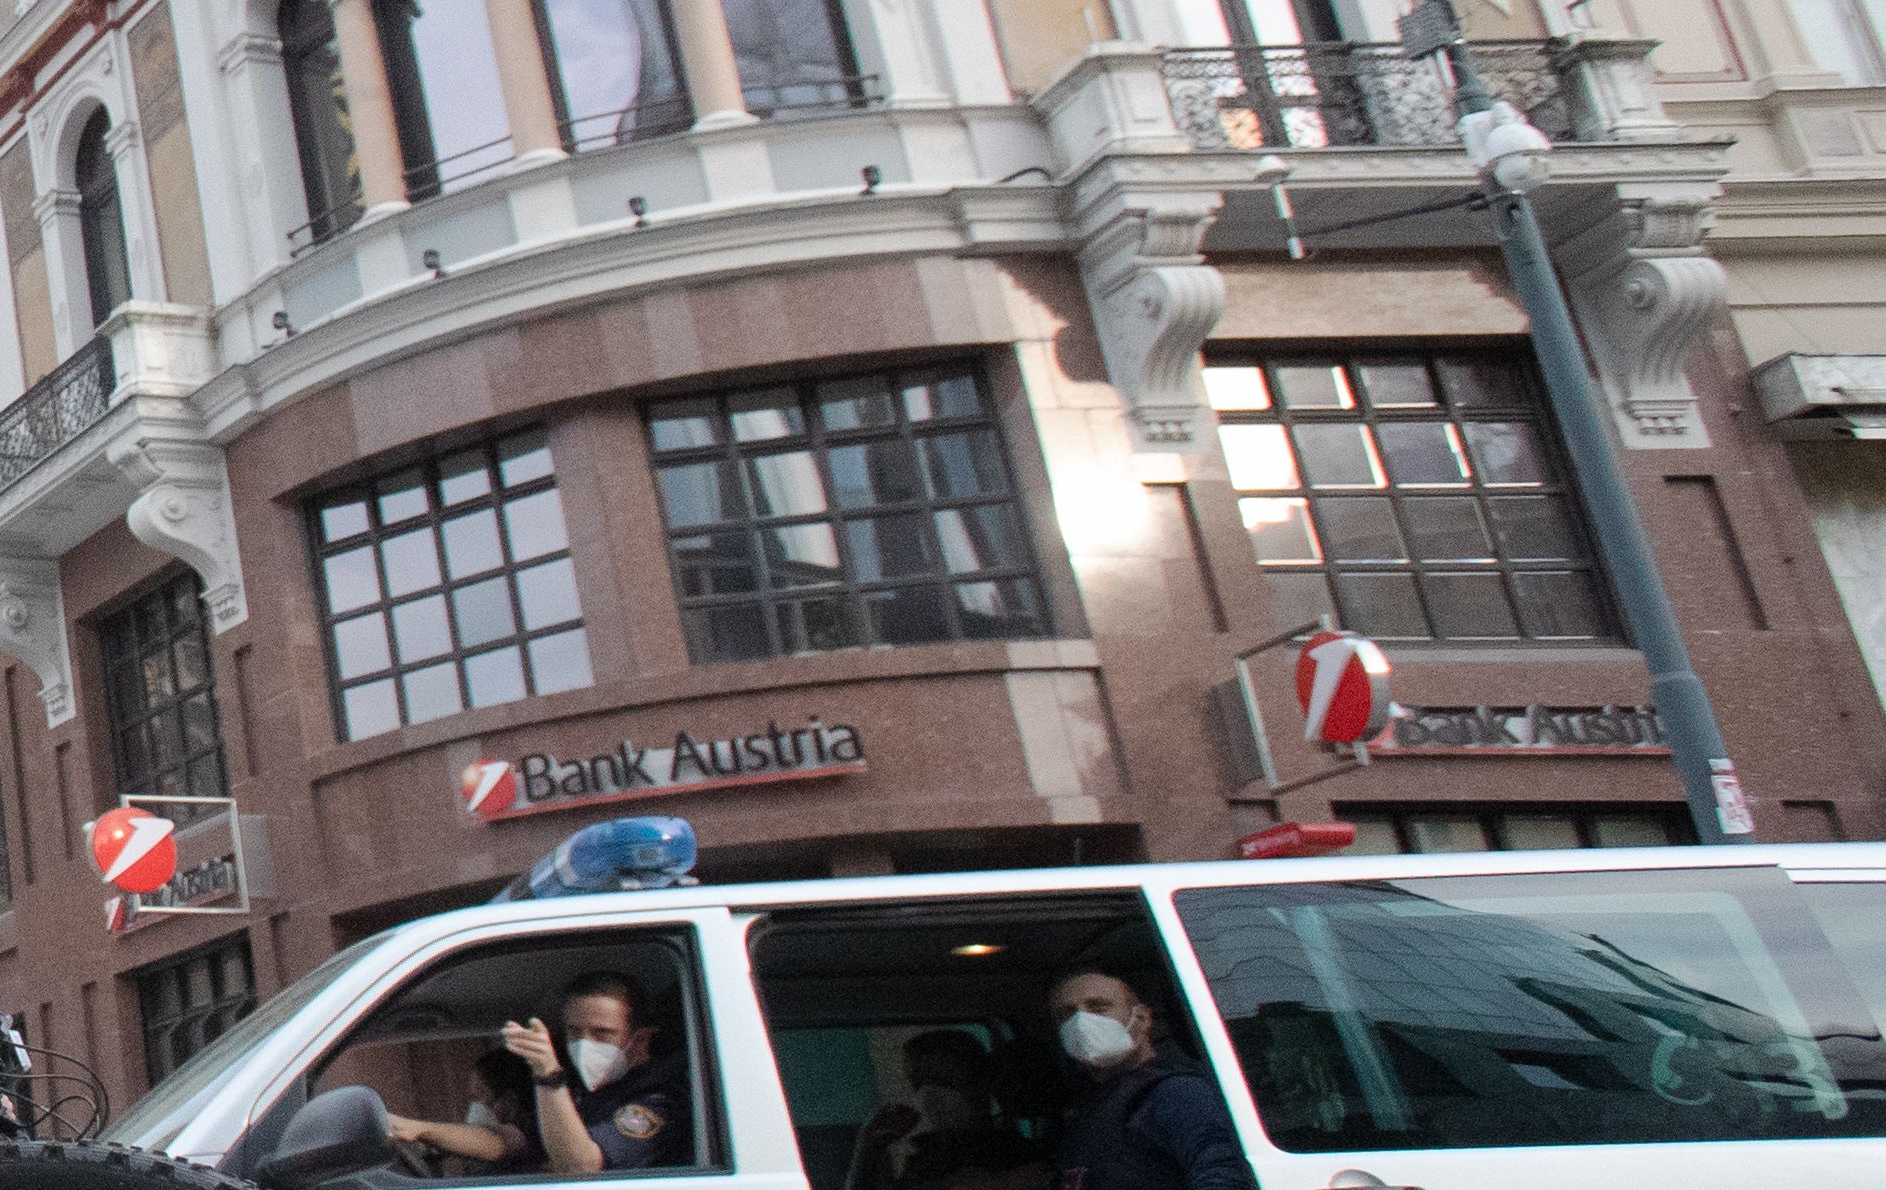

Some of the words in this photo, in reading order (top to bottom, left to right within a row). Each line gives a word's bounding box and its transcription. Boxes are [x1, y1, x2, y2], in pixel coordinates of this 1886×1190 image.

[1525, 704, 1667, 745] Austri
[522, 740, 655, 803] Bank
[670, 714, 866, 783] Austria
